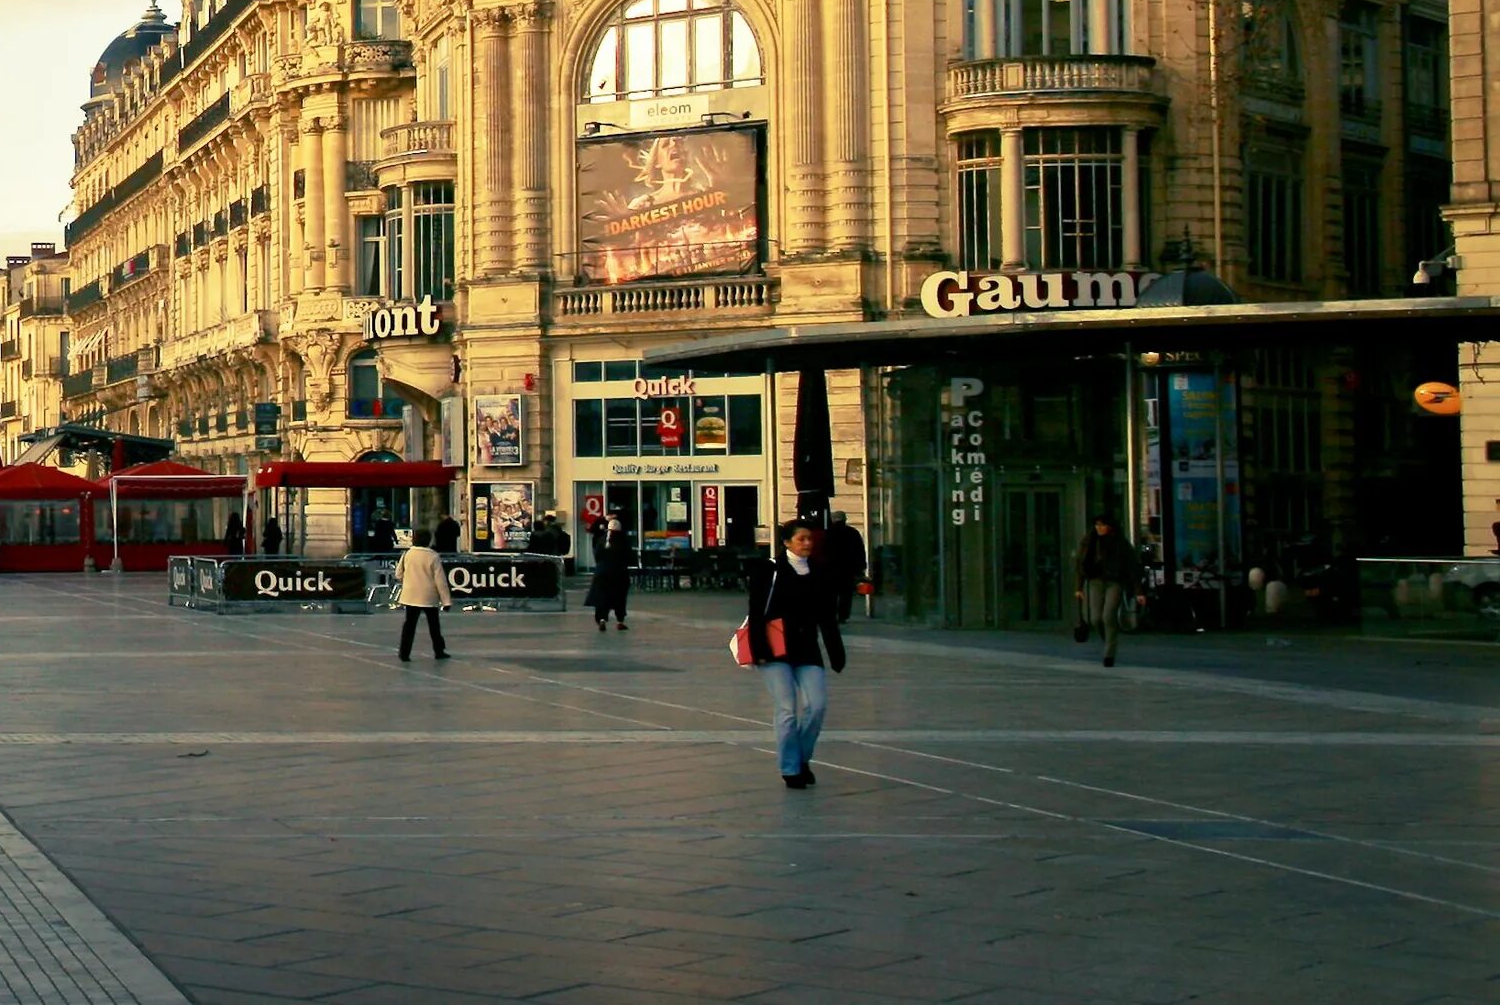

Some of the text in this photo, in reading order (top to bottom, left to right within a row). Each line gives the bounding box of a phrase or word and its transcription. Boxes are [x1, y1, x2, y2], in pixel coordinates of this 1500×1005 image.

[610, 203, 678, 235] DARKEST
[682, 191, 727, 215] HOUR
[633, 375, 694, 400] Quick
[951, 378, 984, 525] Parking
[173, 566, 186, 591] Quick
[200, 567, 213, 593] Quick
[255, 570, 333, 597] Quick
[449, 567, 526, 594] Quick
